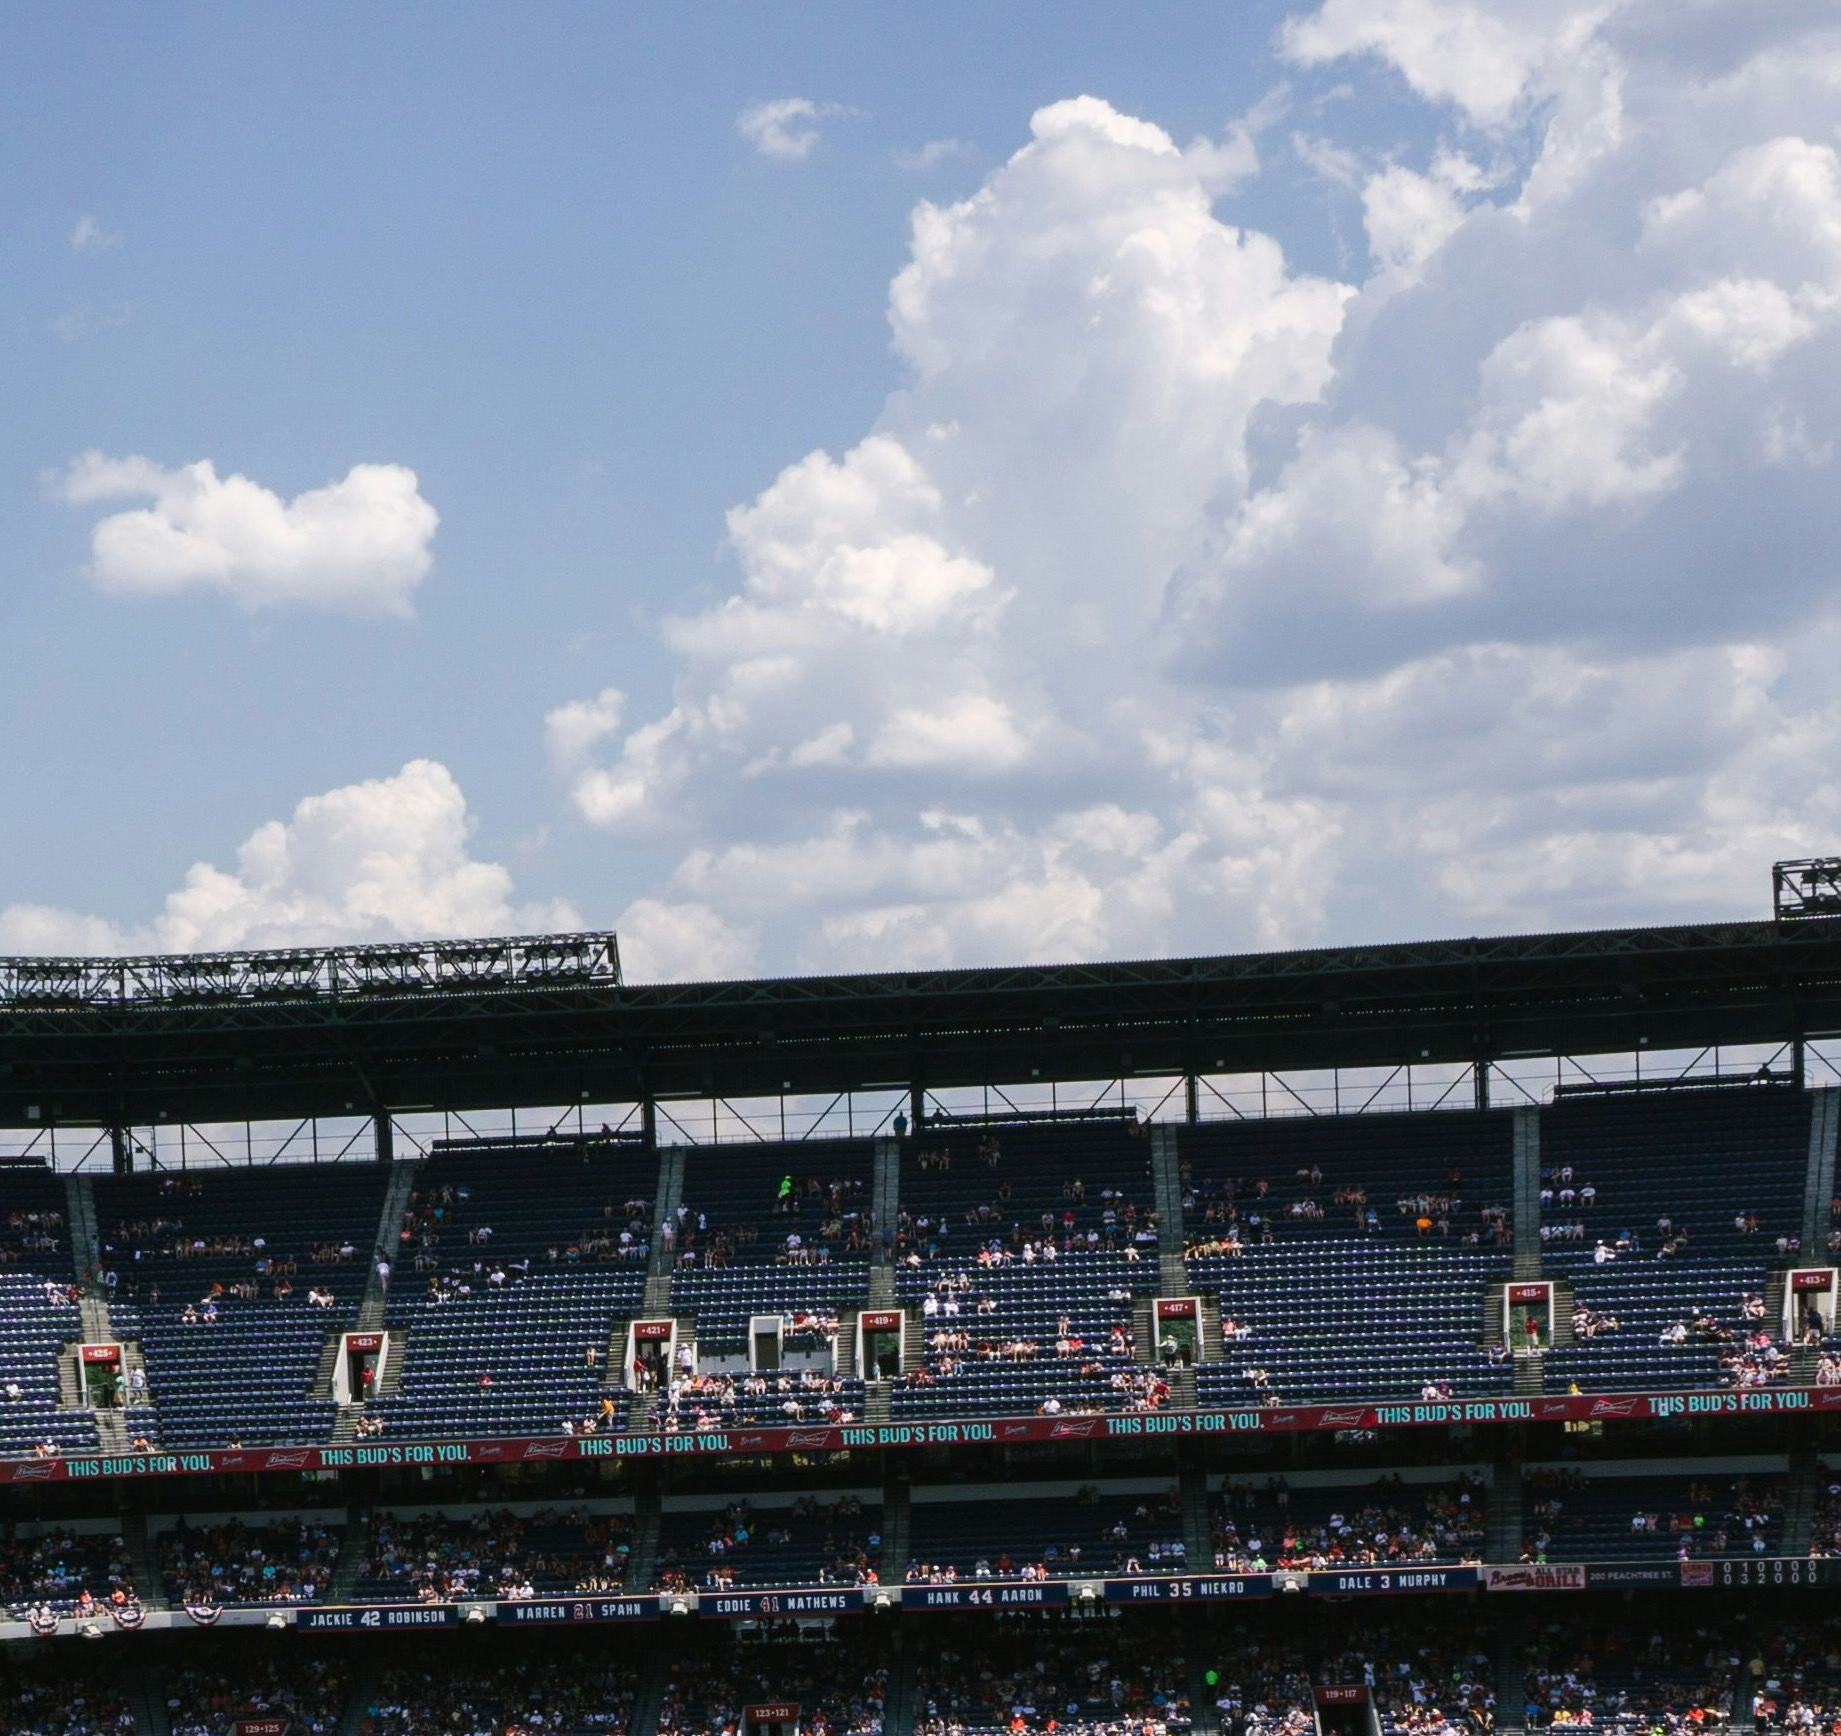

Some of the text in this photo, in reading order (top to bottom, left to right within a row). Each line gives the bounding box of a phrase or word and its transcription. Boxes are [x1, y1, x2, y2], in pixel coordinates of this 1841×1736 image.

[1375, 1403, 1535, 1423] THIS BUD'S FOR YOU.
[1107, 1414, 1264, 1434] THIS BUD'S FOR YOU.
[578, 1440, 612, 1455] THIS
[616, 1438, 661, 1454] BUD'S
[665, 1436, 694, 1451] FOR
[698, 1435, 732, 1451] YOU.
[320, 1445, 471, 1465] THIS BUD'S FOR YOU.
[66, 1456, 214, 1476] THIS BUD'S FOR YOU.
[1339, 1574, 1447, 1590] DALE 3 MURPHY
[1591, 1572, 1607, 1581] 200
[1608, 1571, 1659, 1580] PEACHTREE
[927, 1588, 1043, 1604] HANK 44 AARON
[1133, 1581, 1245, 1598] PHIL 35 NIEKRO
[517, 1604, 641, 1620] WARREN 21 SPAHN
[717, 1596, 846, 1612] EDDIE 41 MATHEWS
[310, 1610, 445, 1627] JACKIE 42 ROBINSON
